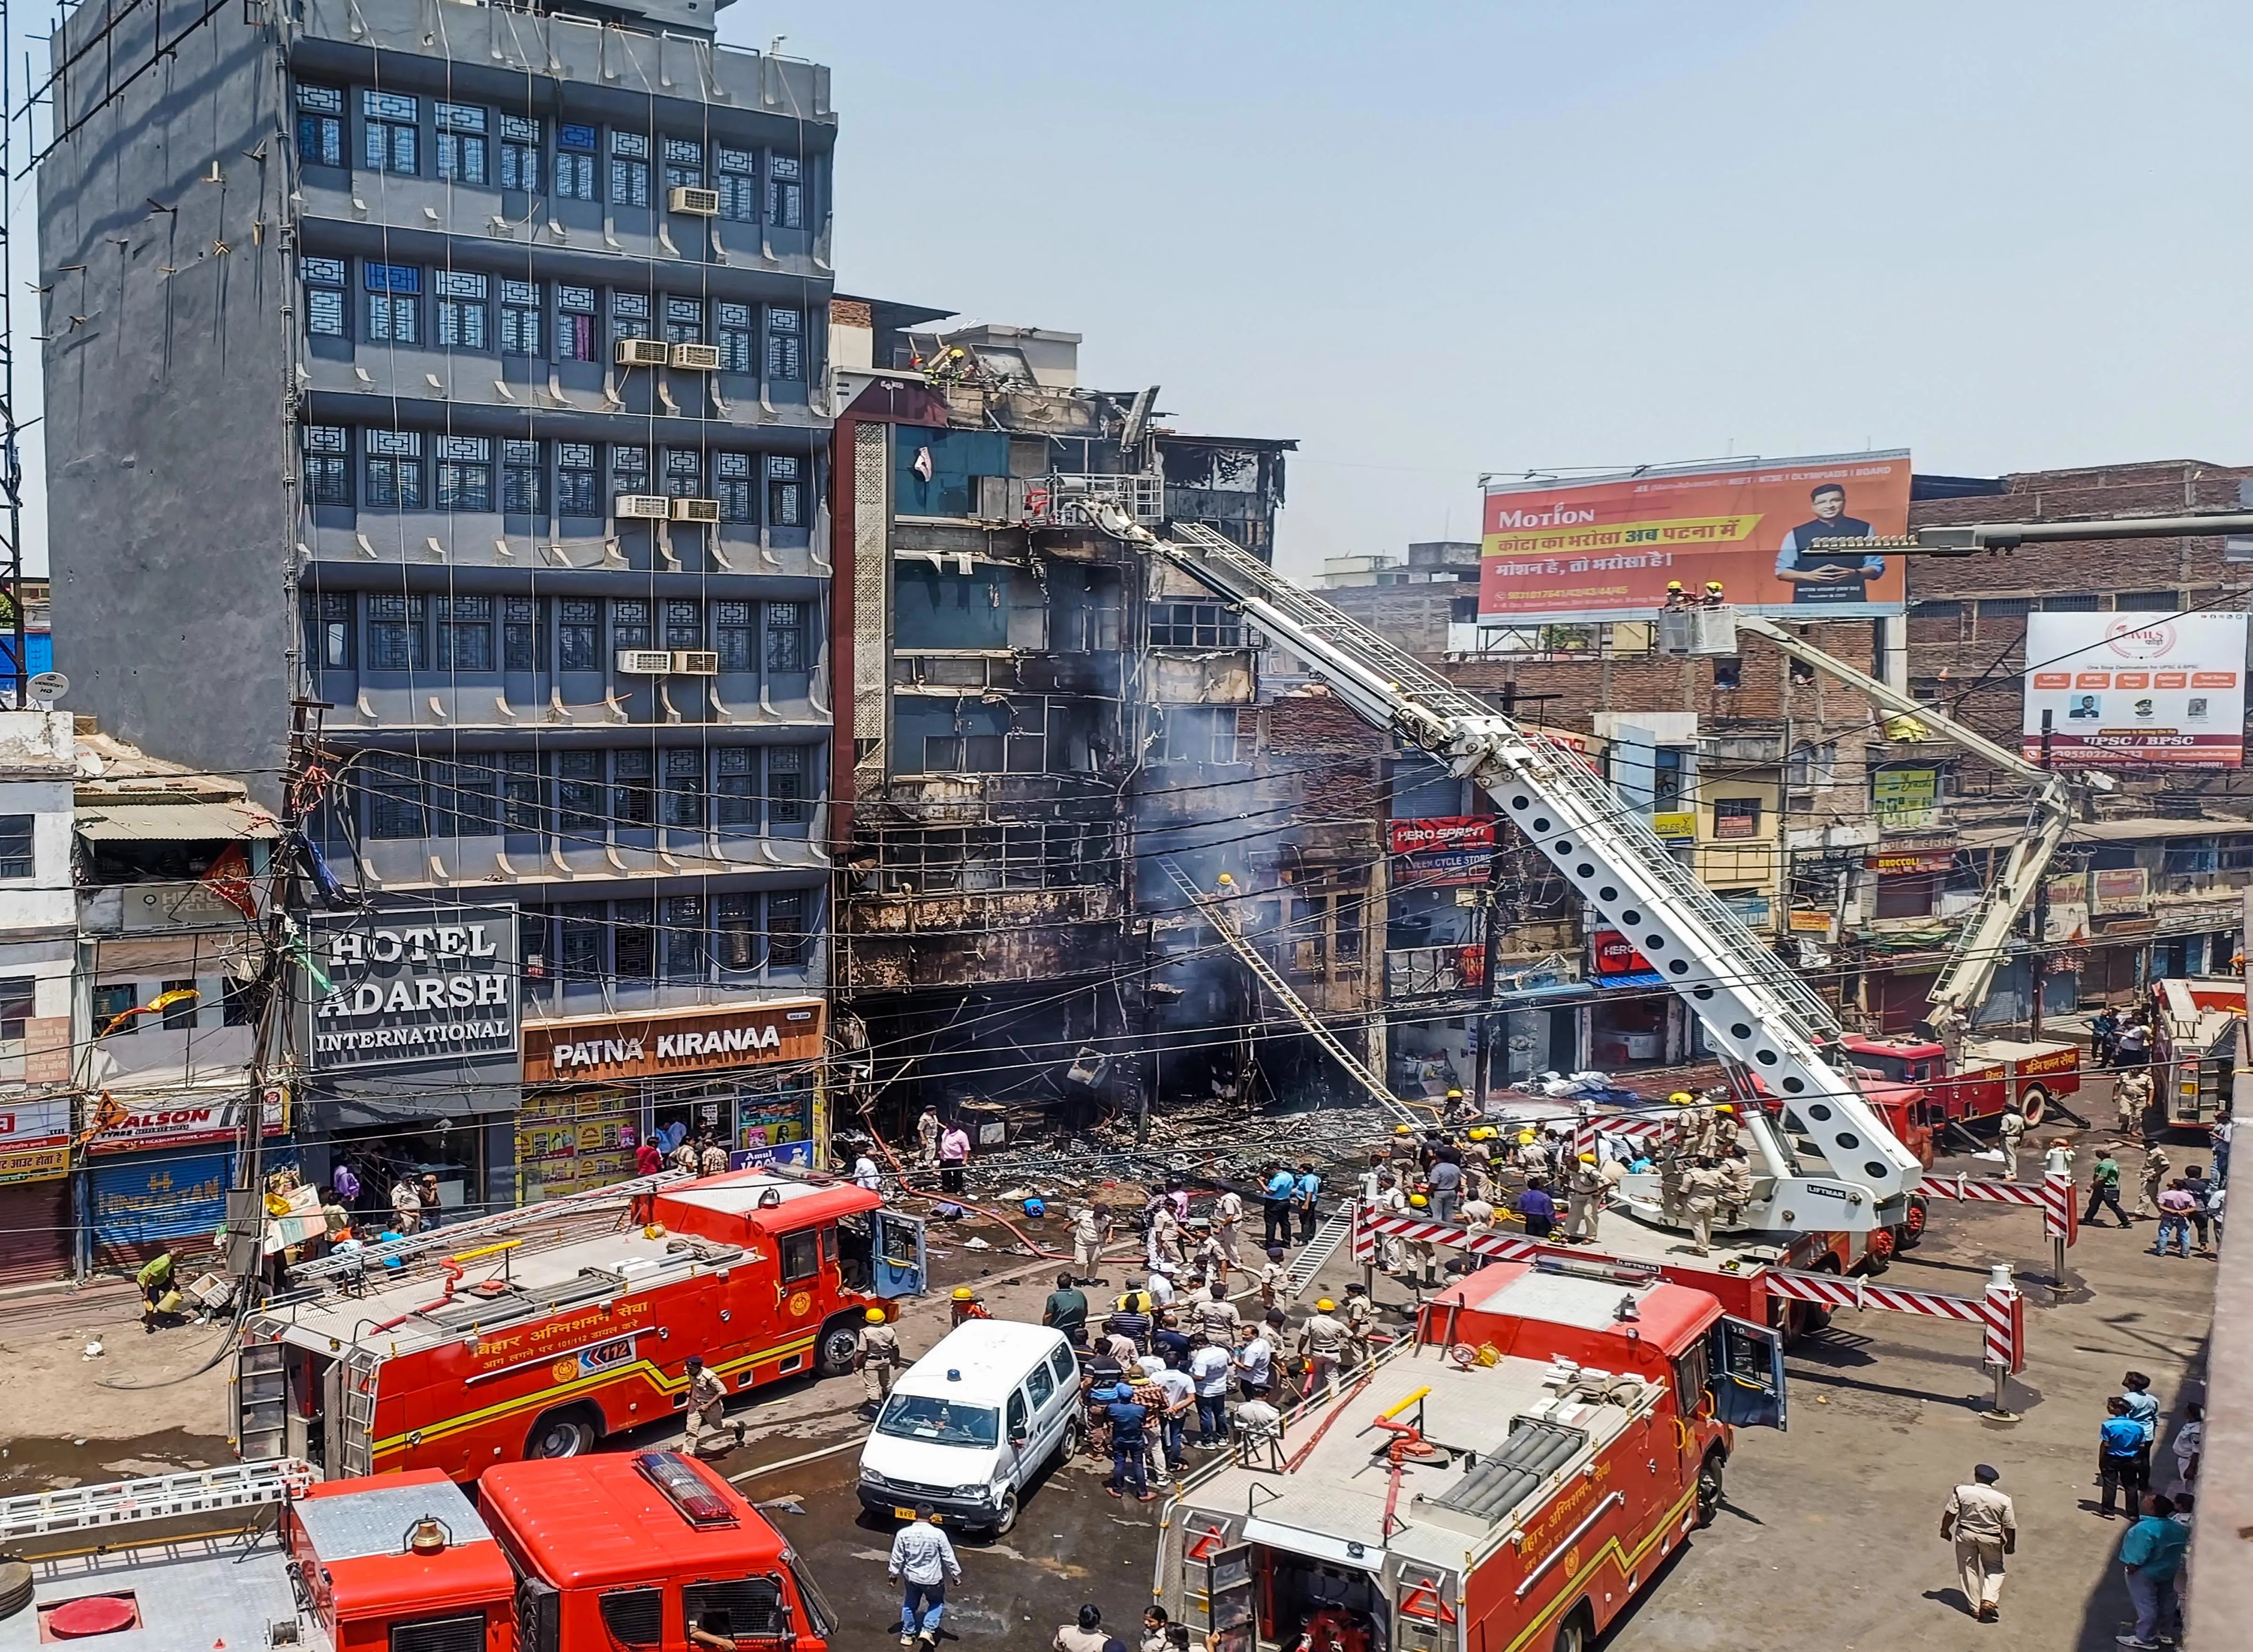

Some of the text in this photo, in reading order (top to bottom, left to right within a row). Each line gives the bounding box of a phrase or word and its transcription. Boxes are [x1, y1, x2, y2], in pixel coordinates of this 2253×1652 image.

[1791, 470, 1847, 480] OLYMPIADS
[1856, 467, 1891, 475] BOARD
[1498, 519, 1740, 552] कोटा का भरोसा अब पटना में
[1495, 560, 1543, 576] मोशन
[1569, 556, 1589, 573] तो
[1593, 553, 1645, 570] भरोसा
[2083, 736, 2132, 745] UPSC
[2146, 736, 2194, 745] BPSC
[1397, 827, 1485, 841] HERO SPRINT
[1435, 857, 1462, 867] CYCLE
[1878, 857, 1920, 868] BROCCOLI
[162, 902, 224, 912] CYCLES
[328, 925, 496, 966] HOTEL
[1604, 945, 1636, 956] HERO
[318, 974, 508, 1017] ADARSH
[315, 1020, 510, 1052] INTERNATIONAL
[554, 1025, 781, 1068] PATNA KIRANAA
[108, 1109, 212, 1131] ALSON
[100, 1129, 132, 1138] TYRES
[10, 1157, 33, 1169] आउट
[35, 1154, 54, 1166] होता
[55, 1152, 63, 1163] है
[745, 1149, 773, 1161] Amul
[1808, 1185, 1846, 1198] LIFTMAK
[1618, 1261, 1659, 1273] LIFTMAK
[474, 1301, 648, 1358] बिहार अग्निशमन सेवा
[483, 1357, 504, 1369] आग
[509, 1347, 534, 1361] लगने
[538, 1344, 553, 1353] पर
[557, 1335, 587, 1348] 101/112
[590, 1326, 618, 1338] डायल
[602, 1342, 628, 1361] 112
[1548, 1482, 1592, 1528] अग्निशमन
[1594, 1460, 1611, 1482] सेवा
